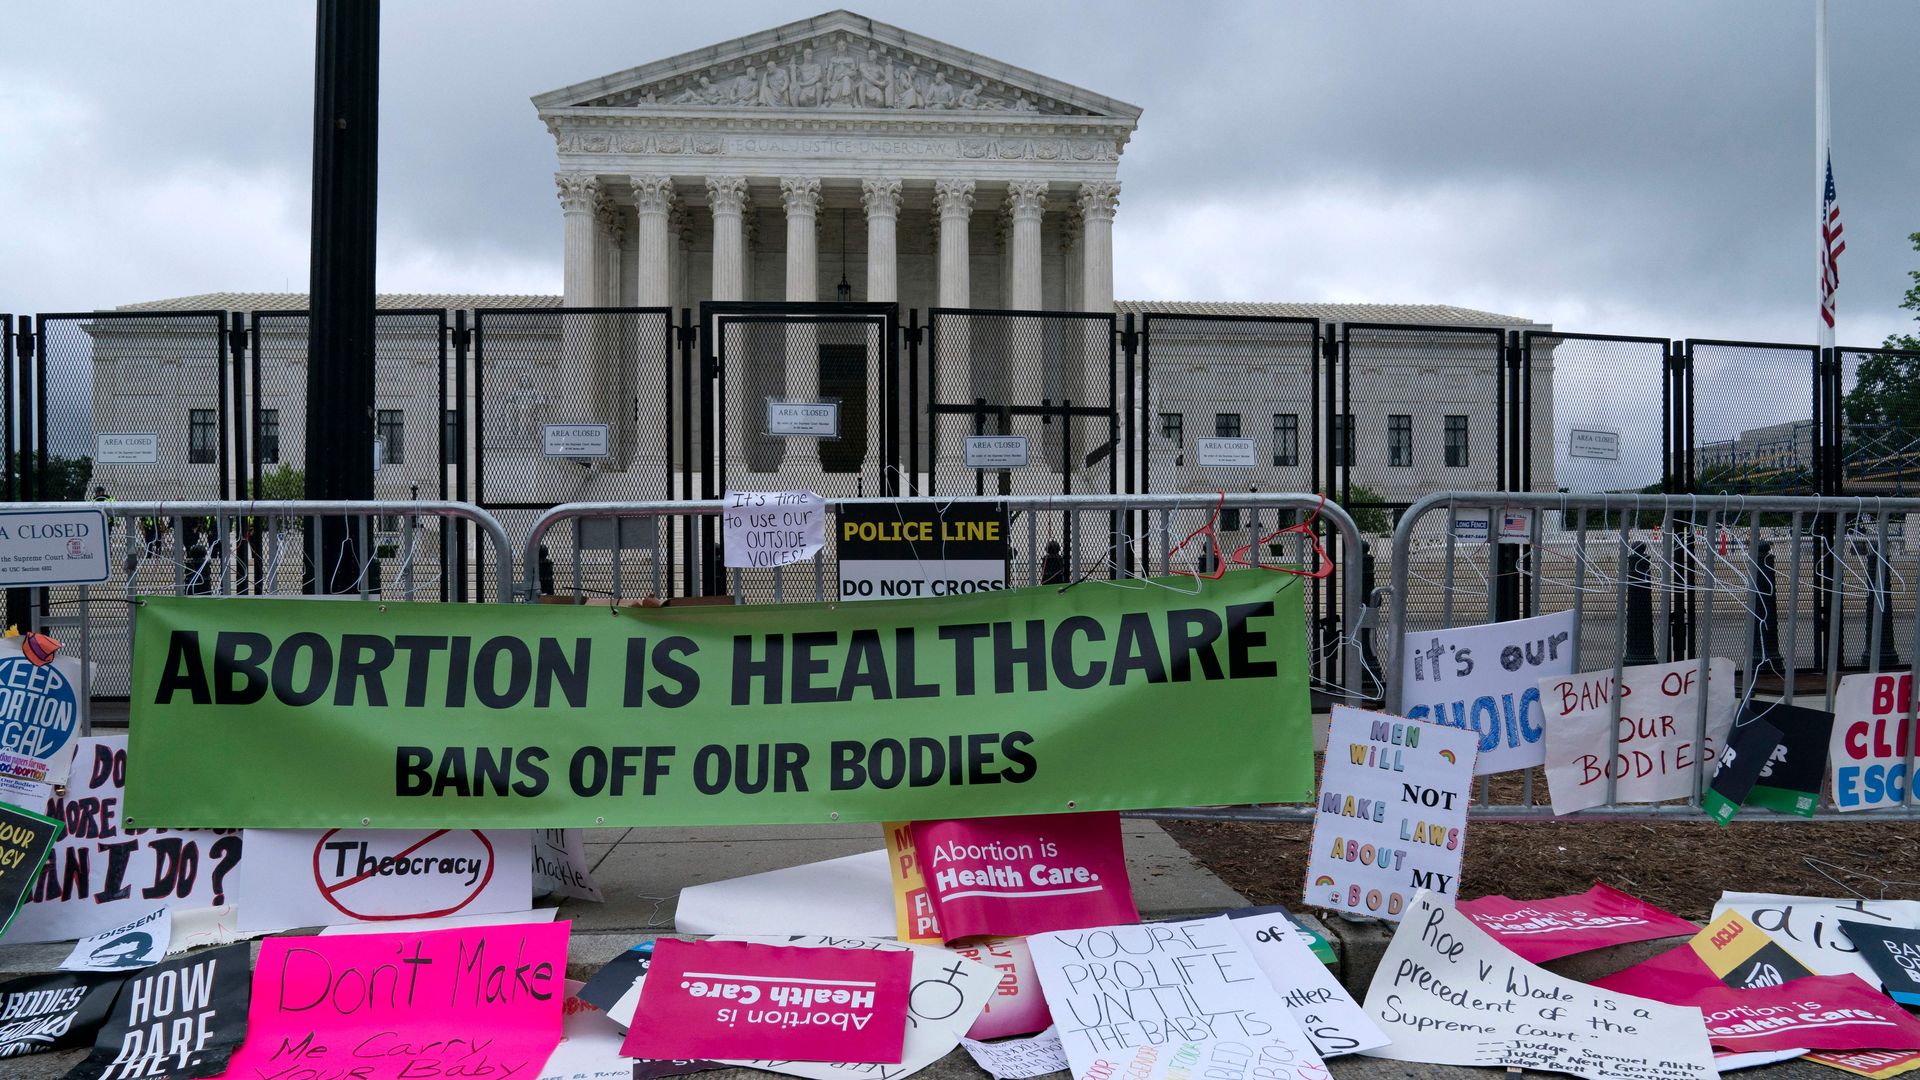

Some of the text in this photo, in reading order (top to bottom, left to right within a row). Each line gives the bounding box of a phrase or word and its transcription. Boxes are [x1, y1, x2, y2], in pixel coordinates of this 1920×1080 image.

[736, 139, 946, 153] EQUAL JUSTICE UNDER LAW
[732, 491, 808, 508] It's time
[18, 523, 89, 539] CLOSED
[724, 511, 813, 529] to use our
[844, 521, 1000, 542] POLICE LINE
[1470, 521, 1487, 529] FENCE
[746, 530, 808, 549] OUTSIDE
[747, 549, 804, 568] VOICES!
[843, 579, 1005, 597] DO NOT CROSS
[154, 601, 1278, 708] ABORTION IS HEALTHCARE
[1413, 631, 1569, 682] it's our
[1554, 676, 1632, 716] BANS
[1370, 720, 1421, 748] MEN
[1617, 714, 1677, 744] OUR
[396, 730, 1038, 797] BANS OFF OUR BODIES
[1572, 736, 1716, 786] BODIES
[1322, 791, 1386, 823] MAKE
[1401, 783, 1457, 811] NOT
[46, 797, 117, 842] MORE
[1399, 818, 1460, 851] LAWS
[325, 841, 482, 886] Theocracy
[532, 845, 595, 893] hackle.
[932, 839, 1033, 869] Abortion
[1040, 837, 1058, 857] is
[1331, 837, 1407, 871] ABOUT
[94, 839, 139, 905] I
[936, 864, 1099, 893] Health Care.
[1410, 868, 1453, 894] MY
[1347, 884, 1404, 915] BOD
[1564, 909, 1588, 917] is
[98, 907, 166, 940] DISSENT
[1256, 926, 1285, 943] of
[1710, 919, 1744, 951] ACLU
[1055, 924, 1227, 960] YOU'RE
[279, 937, 554, 1015] Don't Make
[1062, 951, 1255, 995] PRO-LIFE
[1, 986, 88, 1021] BODIES
[128, 958, 217, 1028] HOW
[680, 980, 875, 1009] Health Care.
[1066, 985, 1245, 1028] UNTIL
[1394, 958, 1639, 1036] precedent of the
[1506, 966, 1574, 1002] Wade
[1593, 998, 1617, 1011] is
[1633, 1007, 1653, 1020] a
[1792, 998, 1822, 1011] is
[716, 1008, 873, 1031] Abortion is
[1381, 994, 1497, 1035] Supreme
[1804, 1007, 1886, 1022] Care.
[269, 1030, 494, 1063] Me Carry
[1068, 1022, 1141, 1053] THE
[1139, 1014, 1218, 1046] BABY
[401, 1055, 529, 1080] Baby
[1548, 1061, 1586, 1073] Brett
[1568, 1056, 1604, 1068] Neil
[1614, 1063, 1696, 1078] Gorsuch
[1583, 1048, 1648, 1066] Samuel
[1659, 1060, 1706, 1071] Alito
